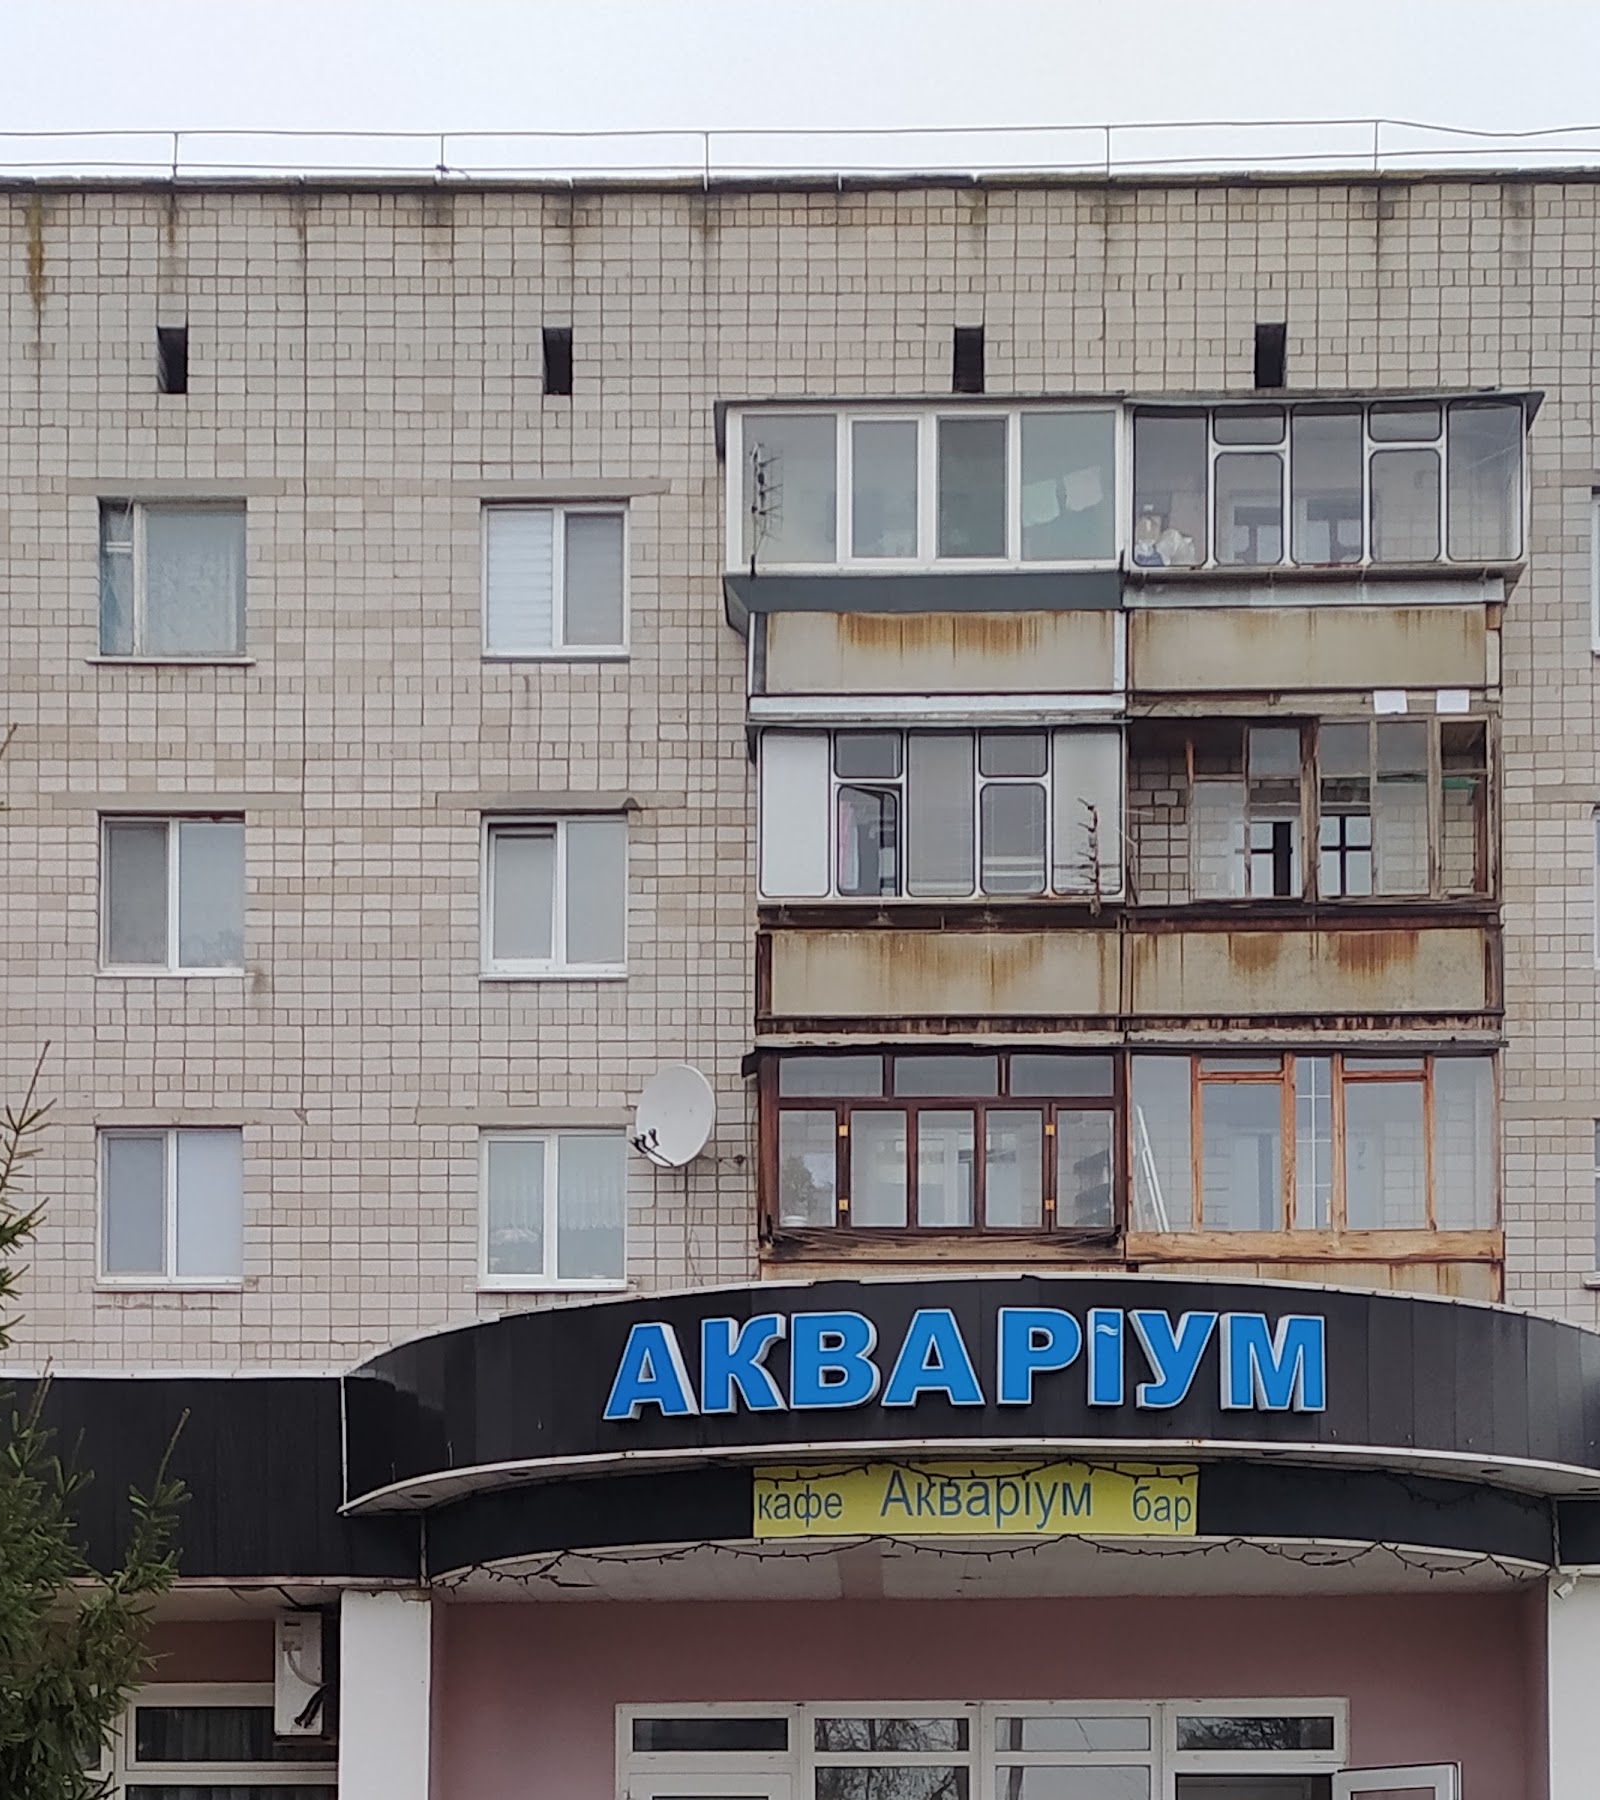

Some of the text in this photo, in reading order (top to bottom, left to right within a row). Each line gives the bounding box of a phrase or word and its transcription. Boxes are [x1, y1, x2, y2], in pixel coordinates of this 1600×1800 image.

[758, 1469, 1192, 1531] кафе Акваріум бар
